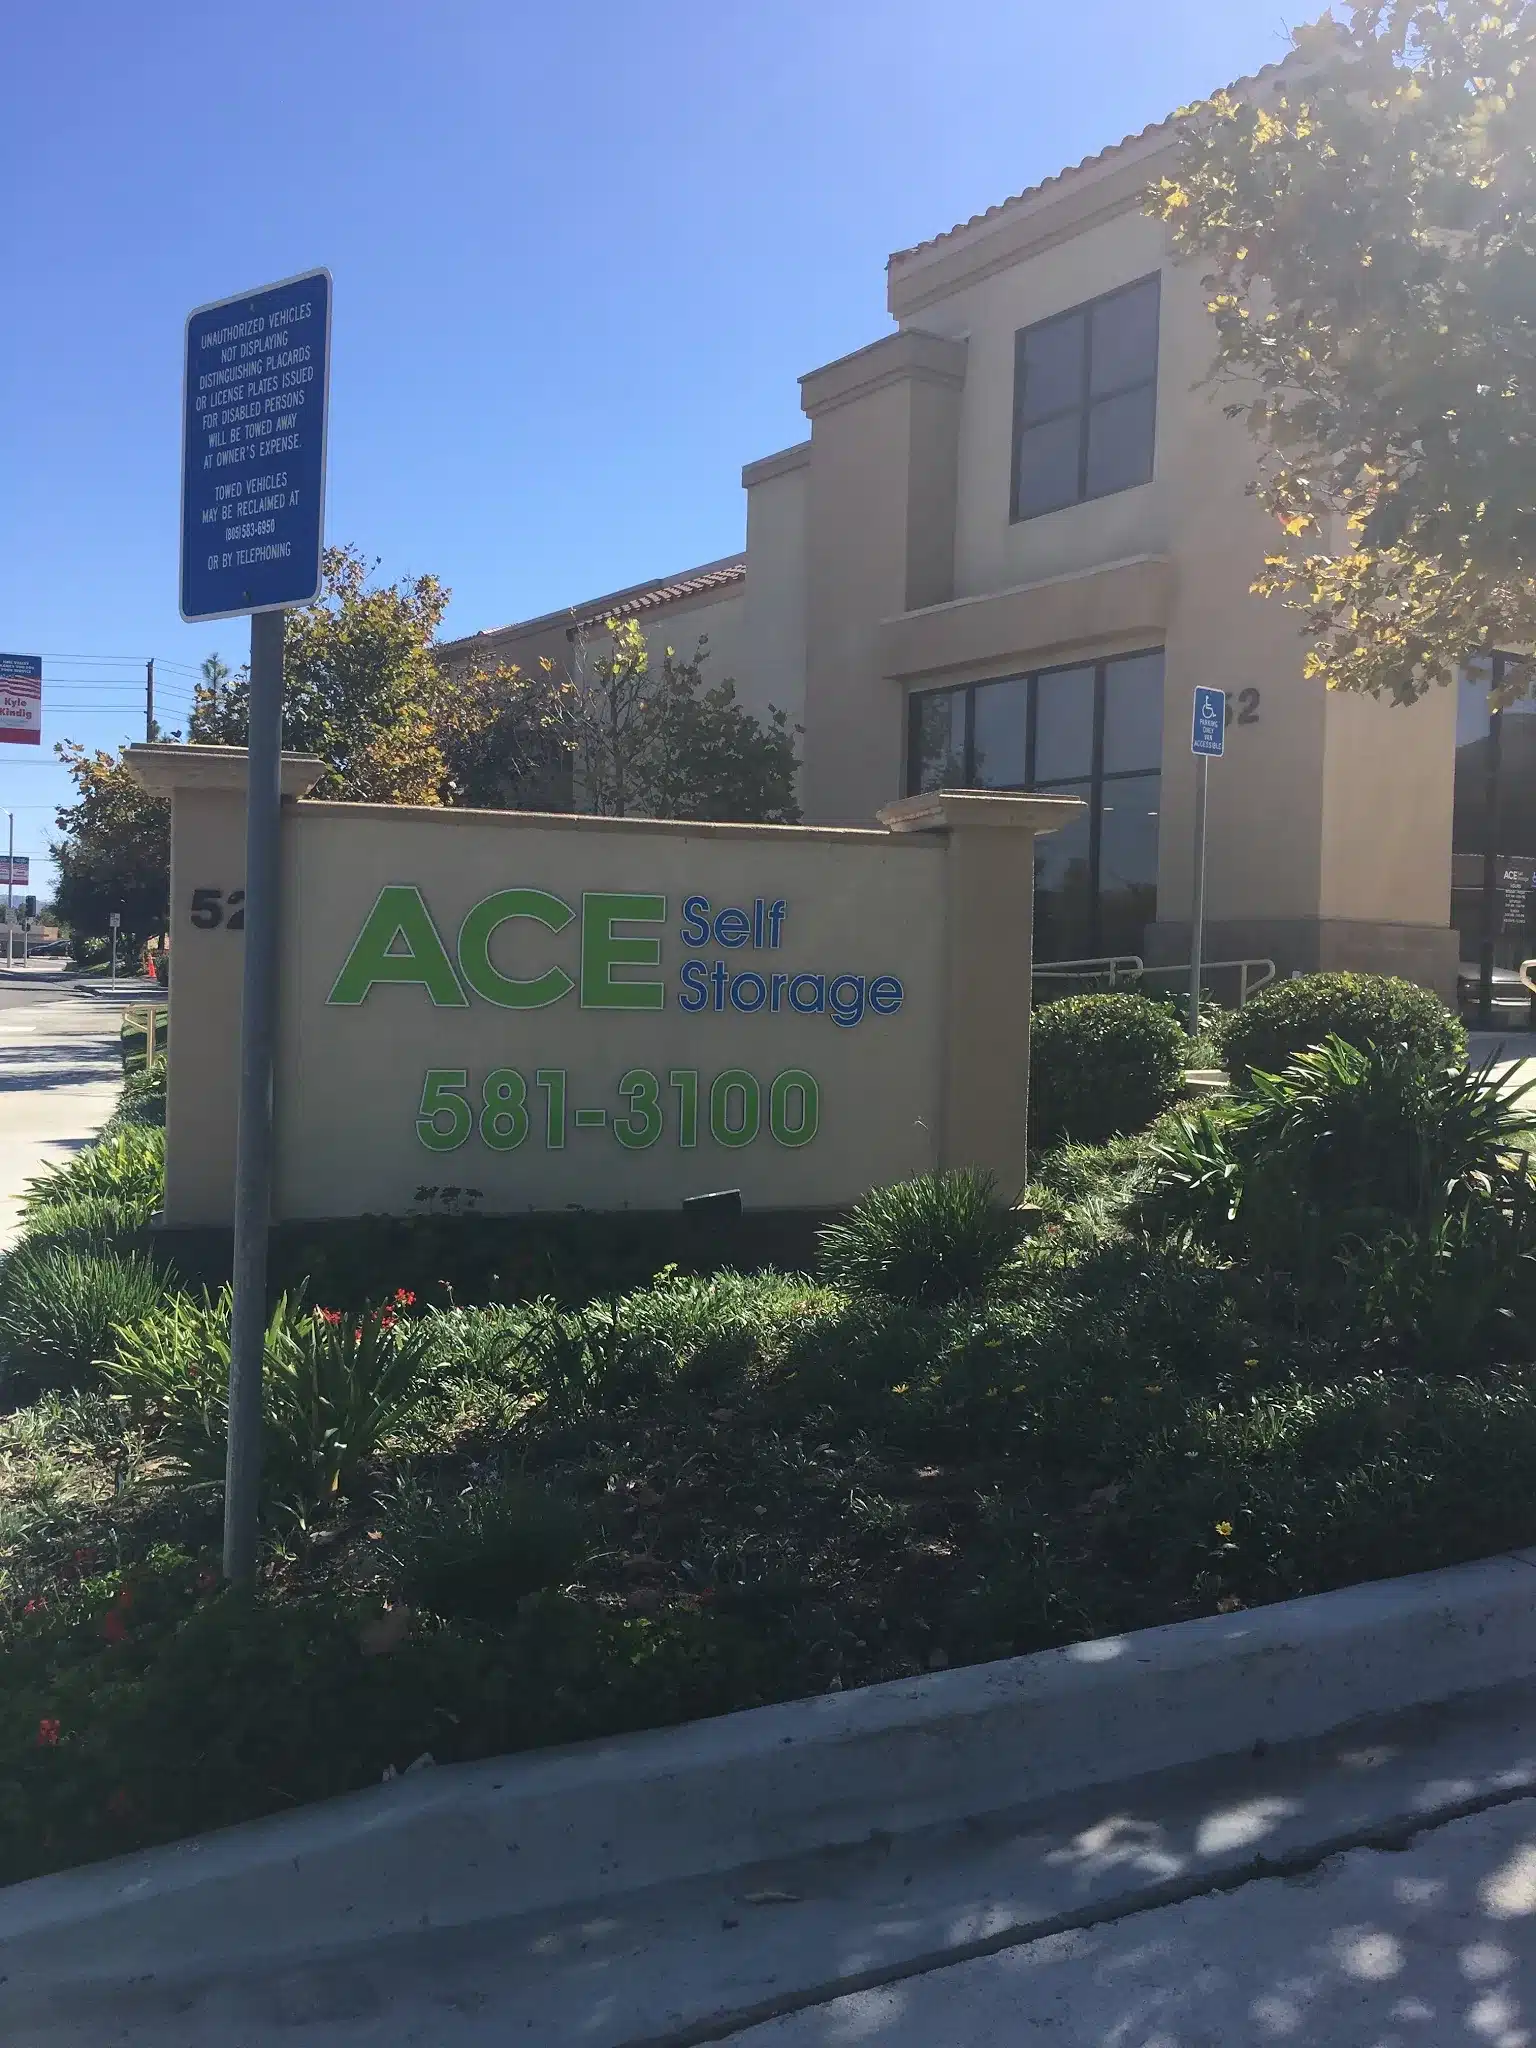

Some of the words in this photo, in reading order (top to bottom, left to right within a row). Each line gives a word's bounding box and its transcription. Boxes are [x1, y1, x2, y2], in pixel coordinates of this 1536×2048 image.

[201, 317, 264, 349] UNAUTHORIZED
[269, 302, 312, 328] VEHICLES
[221, 345, 237, 363] NOT
[240, 331, 288, 358] DISPLAYING
[200, 359, 263, 390] DISTINGUISHING
[266, 345, 311, 371] PLACARDS
[196, 396, 206, 412] OR
[210, 385, 244, 408] LICENSE
[248, 375, 278, 397] PLATES
[282, 366, 314, 389] ISSUED
[203, 414, 218, 430] FOR
[222, 401, 261, 424] DISABLED
[265, 390, 305, 413] PERSONS
[208, 431, 227, 448] WILL
[230, 427, 241, 443] BE
[245, 419, 272, 439] TOWED
[276, 413, 298, 431] AWAY
[203, 455, 213, 470] AT
[216, 444, 255, 466] OWNER'S
[259, 434, 302, 456] EXPENSE.
[215, 481, 242, 501] TOWED
[246, 471, 288, 494] VEHICLES
[202, 507, 218, 524] MAY
[222, 504, 232, 520] BE
[237, 493, 285, 517] RECLAIMED
[289, 490, 300, 506] AT
[208, 555, 219, 570] OR
[222, 552, 233, 568] BY
[236, 541, 291, 566] TELEPHONING
[0, 708, 32, 720] Kindig
[4, 697, 27, 707] Kyle
[1194, 740, 1222, 750] ACCESSIBLE
[1503, 870, 1518, 880] ACE
[680, 895, 787, 950] Self
[325, 885, 666, 1010] ACE
[679, 960, 905, 1028] Storage
[415, 1068, 820, 1151] 581-3100
